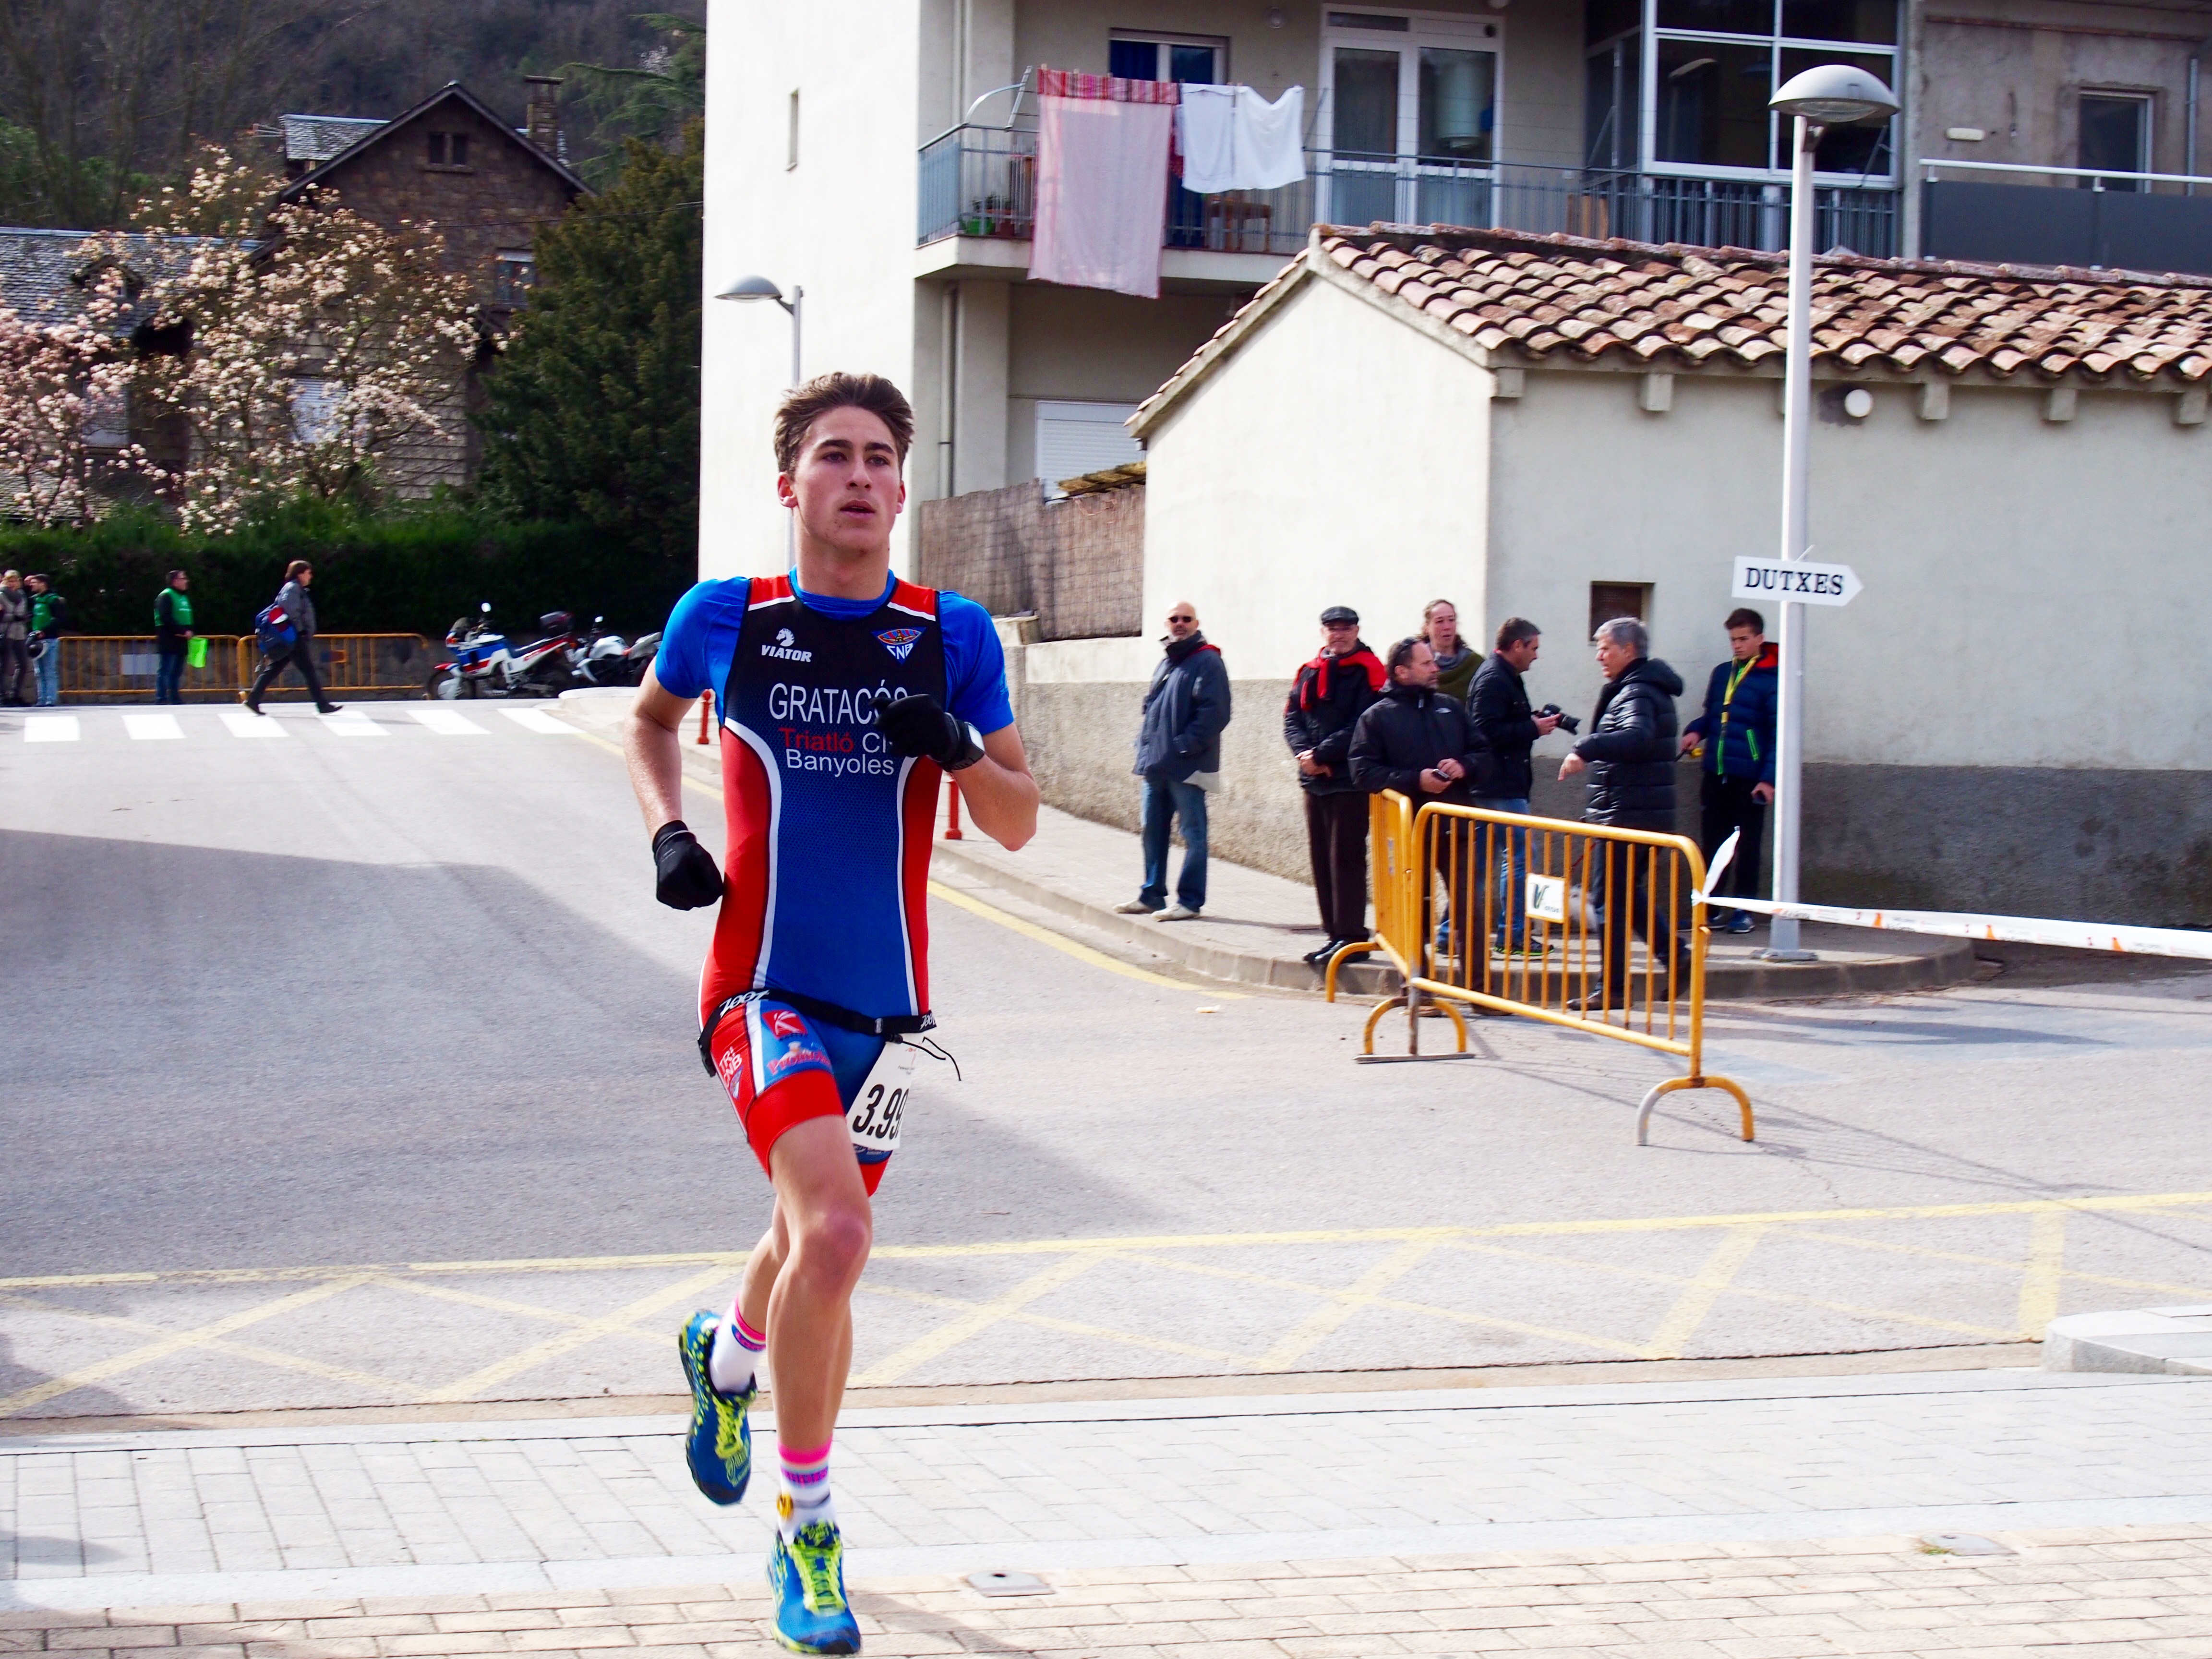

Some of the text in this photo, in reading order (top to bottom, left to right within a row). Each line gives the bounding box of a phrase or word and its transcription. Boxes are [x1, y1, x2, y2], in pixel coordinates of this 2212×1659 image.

[1744, 567, 1843, 596] DUTXES
[761, 644, 812, 663] VIATOR
[886, 643, 914, 660] CNB
[778, 727, 855, 753] Triatló
[785, 748, 894, 778] Banyoles
